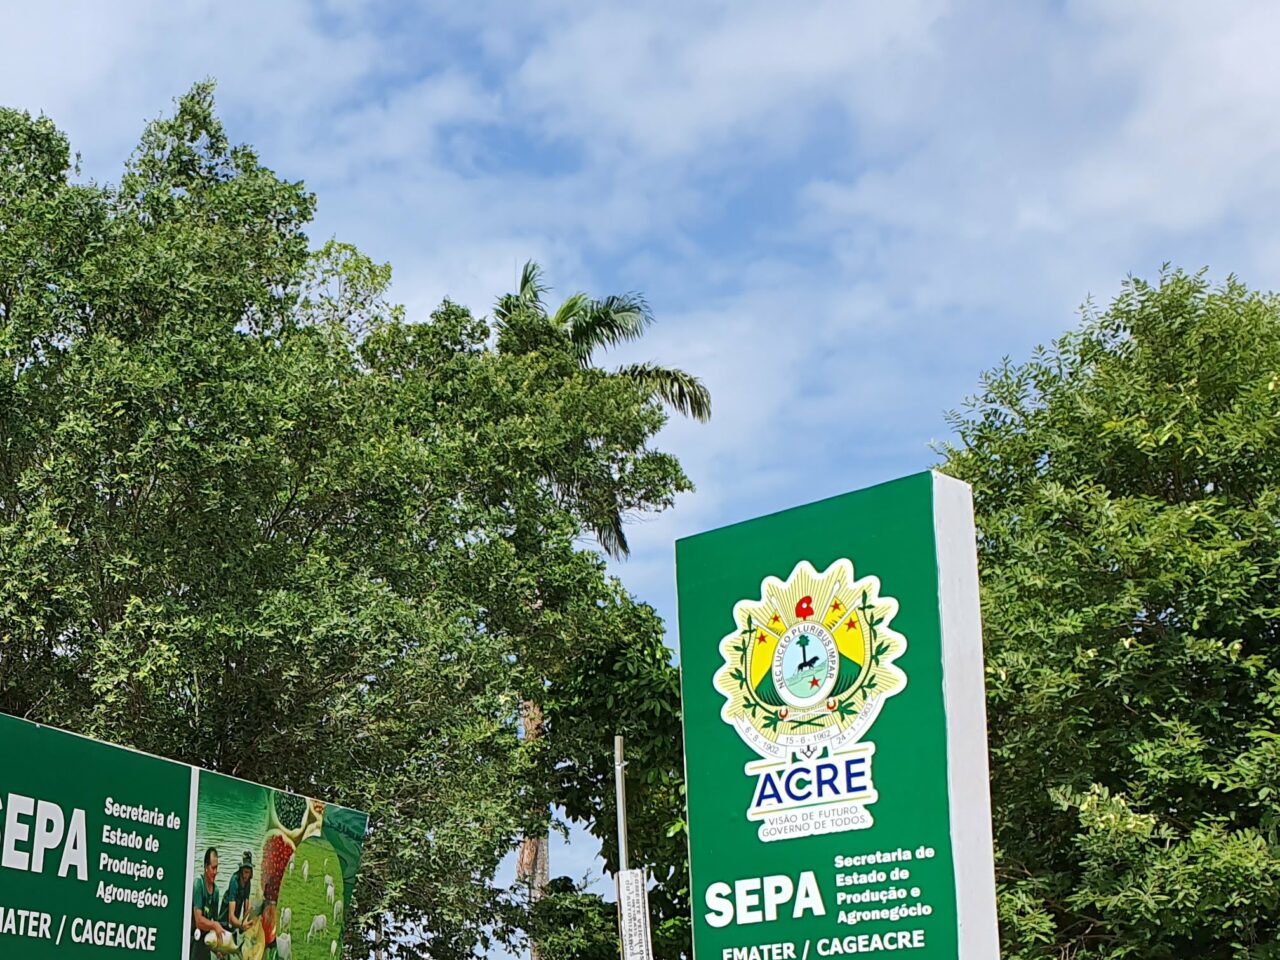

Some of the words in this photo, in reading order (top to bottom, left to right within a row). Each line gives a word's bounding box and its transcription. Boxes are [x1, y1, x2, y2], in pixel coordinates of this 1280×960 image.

[791, 625, 832, 647] PLURIBUS
[775, 635, 791, 667] LUCEO
[826, 648, 836, 679] IMPAR
[775, 670, 785, 689] NEC
[755, 757, 868, 808] ACRE
[104, 797, 165, 828] Secretaria
[167, 811, 181, 831] de
[768, 813, 798, 827] VISÃO
[802, 811, 815, 822] DE
[102, 825, 142, 852] Estado
[145, 833, 159, 853] de
[762, 823, 810, 838] GOVERNO
[814, 821, 827, 830] DE
[99, 853, 154, 881] Produção
[156, 866, 164, 880] e
[834, 847, 912, 868] Secretaria
[915, 845, 935, 860] de
[835, 868, 887, 887] Estado
[890, 867, 910, 881] de
[96, 881, 168, 909] Agronegócio
[704, 870, 825, 928] SEPA
[836, 886, 907, 906] Produção
[910, 886, 920, 898] e
[837, 902, 932, 925] Agronegócio
[56, 915, 67, 946] /
[71, 917, 158, 952] CAGEACRE
[802, 940, 811, 960] /
[817, 929, 926, 957] CAGEACRE
